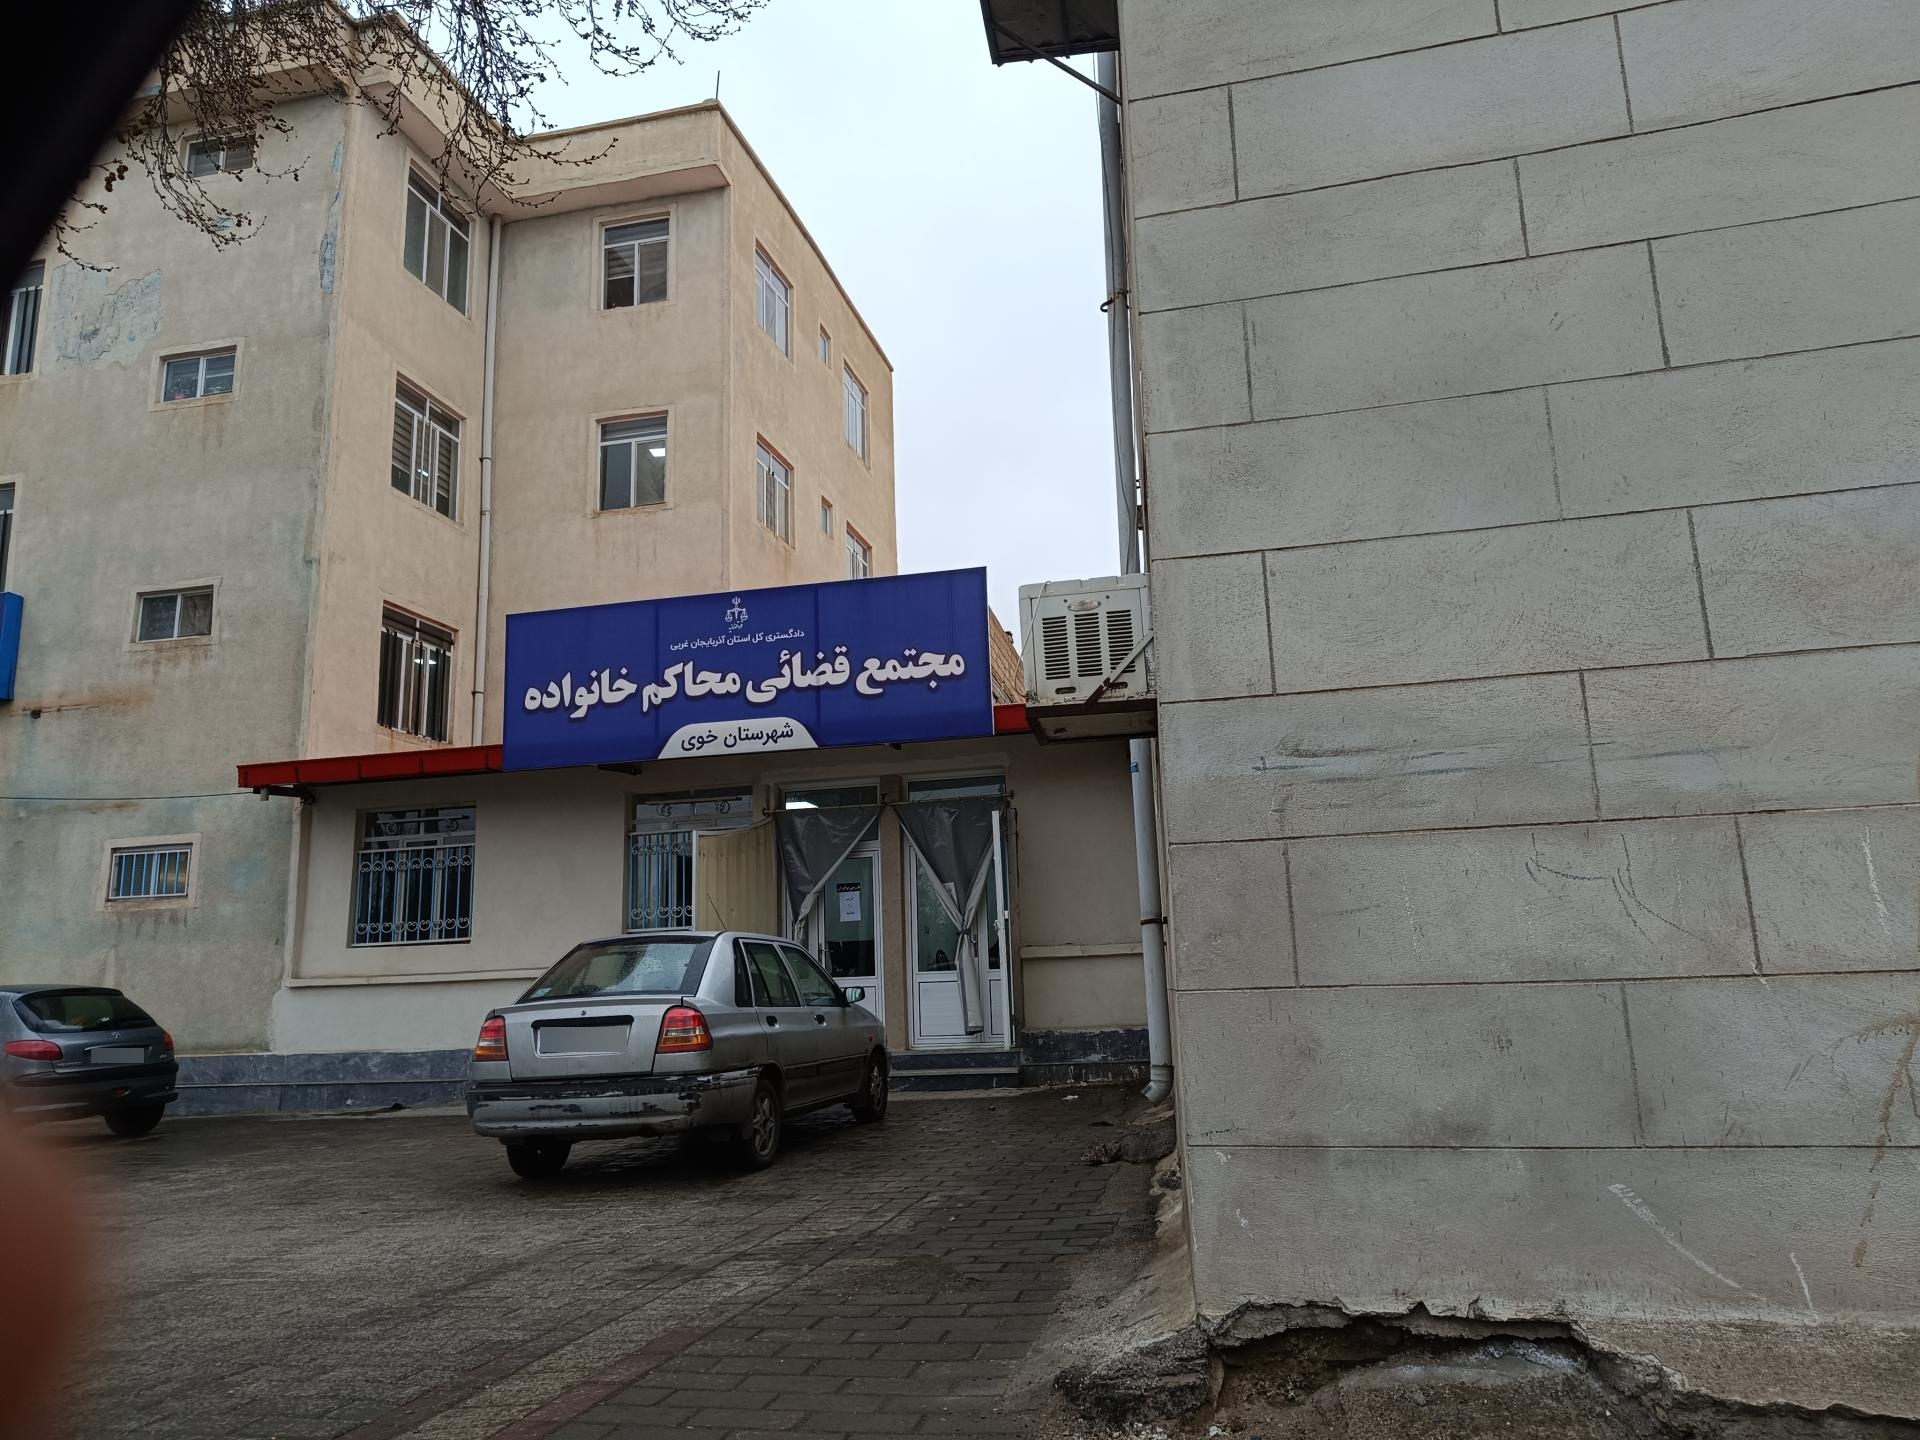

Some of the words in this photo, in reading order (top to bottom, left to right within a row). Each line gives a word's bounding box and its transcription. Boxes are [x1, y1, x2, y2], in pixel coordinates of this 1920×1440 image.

[670, 639, 689, 651] غربی
[690, 635, 726, 649] آذربایجان
[727, 634, 751, 646] استان
[752, 632, 764, 644] کل
[765, 628, 805, 643] دادگستری
[745, 645, 851, 703] قضائی
[855, 648, 965, 695] مجتمع
[524, 667, 638, 718] خانواده
[642, 661, 741, 712] محاکم
[681, 729, 718, 752] خوی
[723, 722, 794, 748] شهرستان
